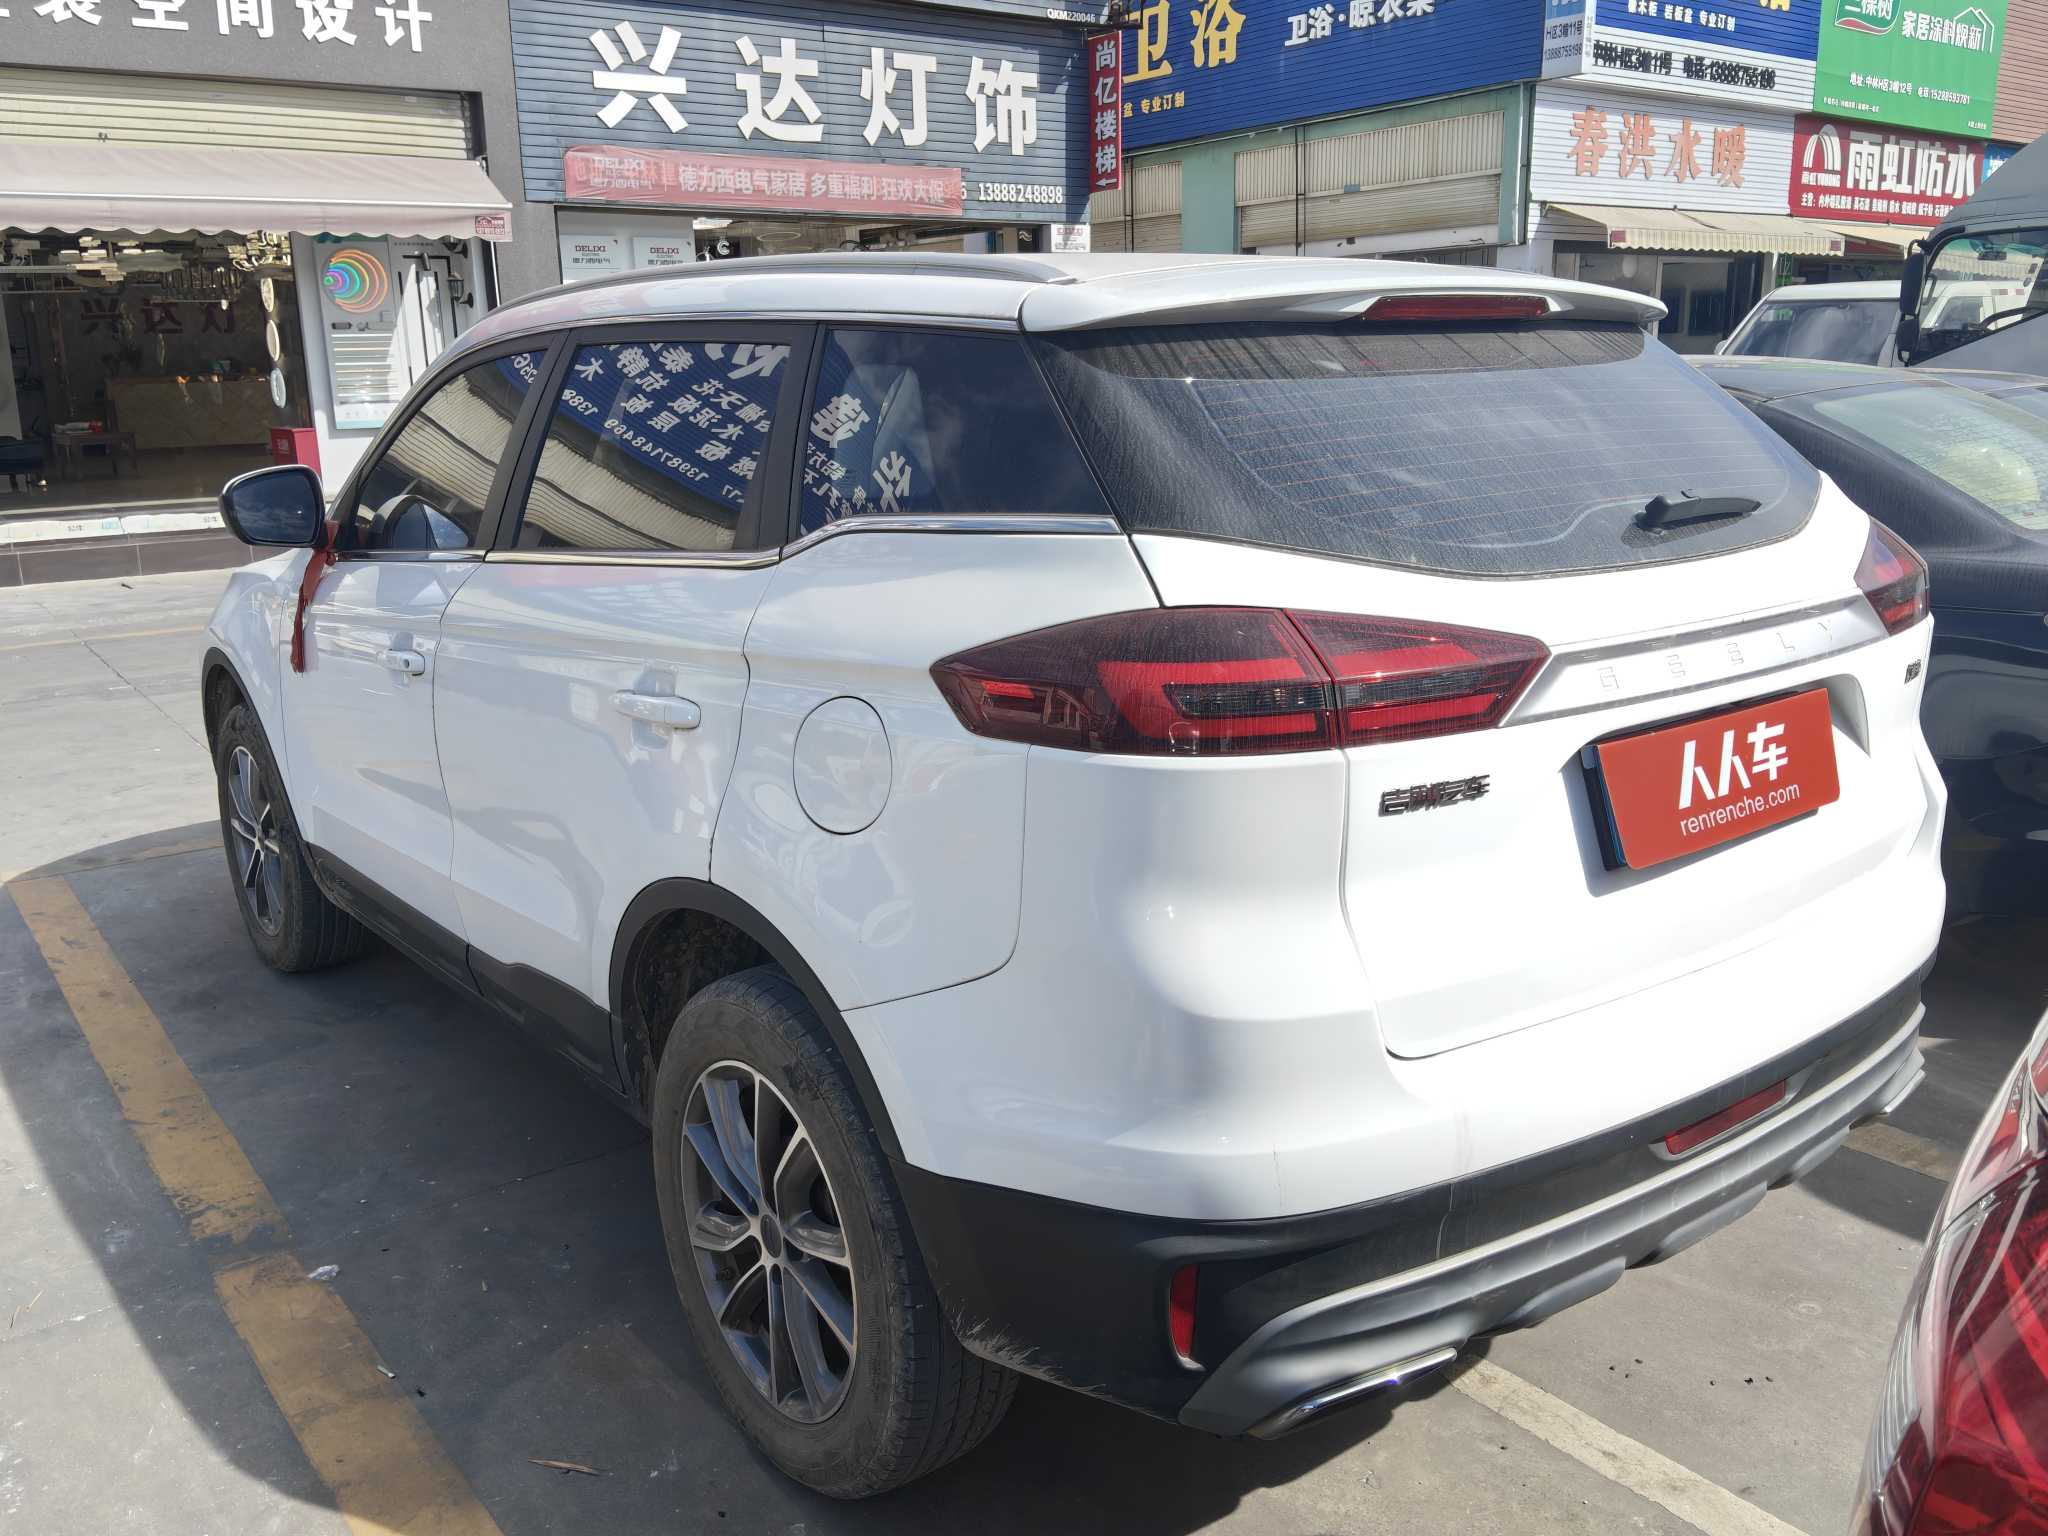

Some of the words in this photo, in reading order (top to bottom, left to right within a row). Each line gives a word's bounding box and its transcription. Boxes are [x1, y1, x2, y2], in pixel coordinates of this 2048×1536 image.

[0, 0, 433, 53] 空间设计
[1122, 0, 1247, 84] 卫浴
[1902, 10, 1983, 51] 家居涂料焕新
[589, 20, 1039, 156] 兴达灯饰
[1095, 40, 1117, 174] 尚亿楼梯
[1141, 91, 1185, 114] 专业订制
[1567, 105, 1745, 188] 春洪水暖
[1846, 131, 1976, 199] 雨虹防水
[679, 163, 807, 198] 德力西电气家居
[811, 172, 877, 201] 多重福利
[978, 182, 1063, 204] 13888248898
[1679, 721, 1789, 810] 人人车
[1680, 784, 1800, 836] renrenche.com
